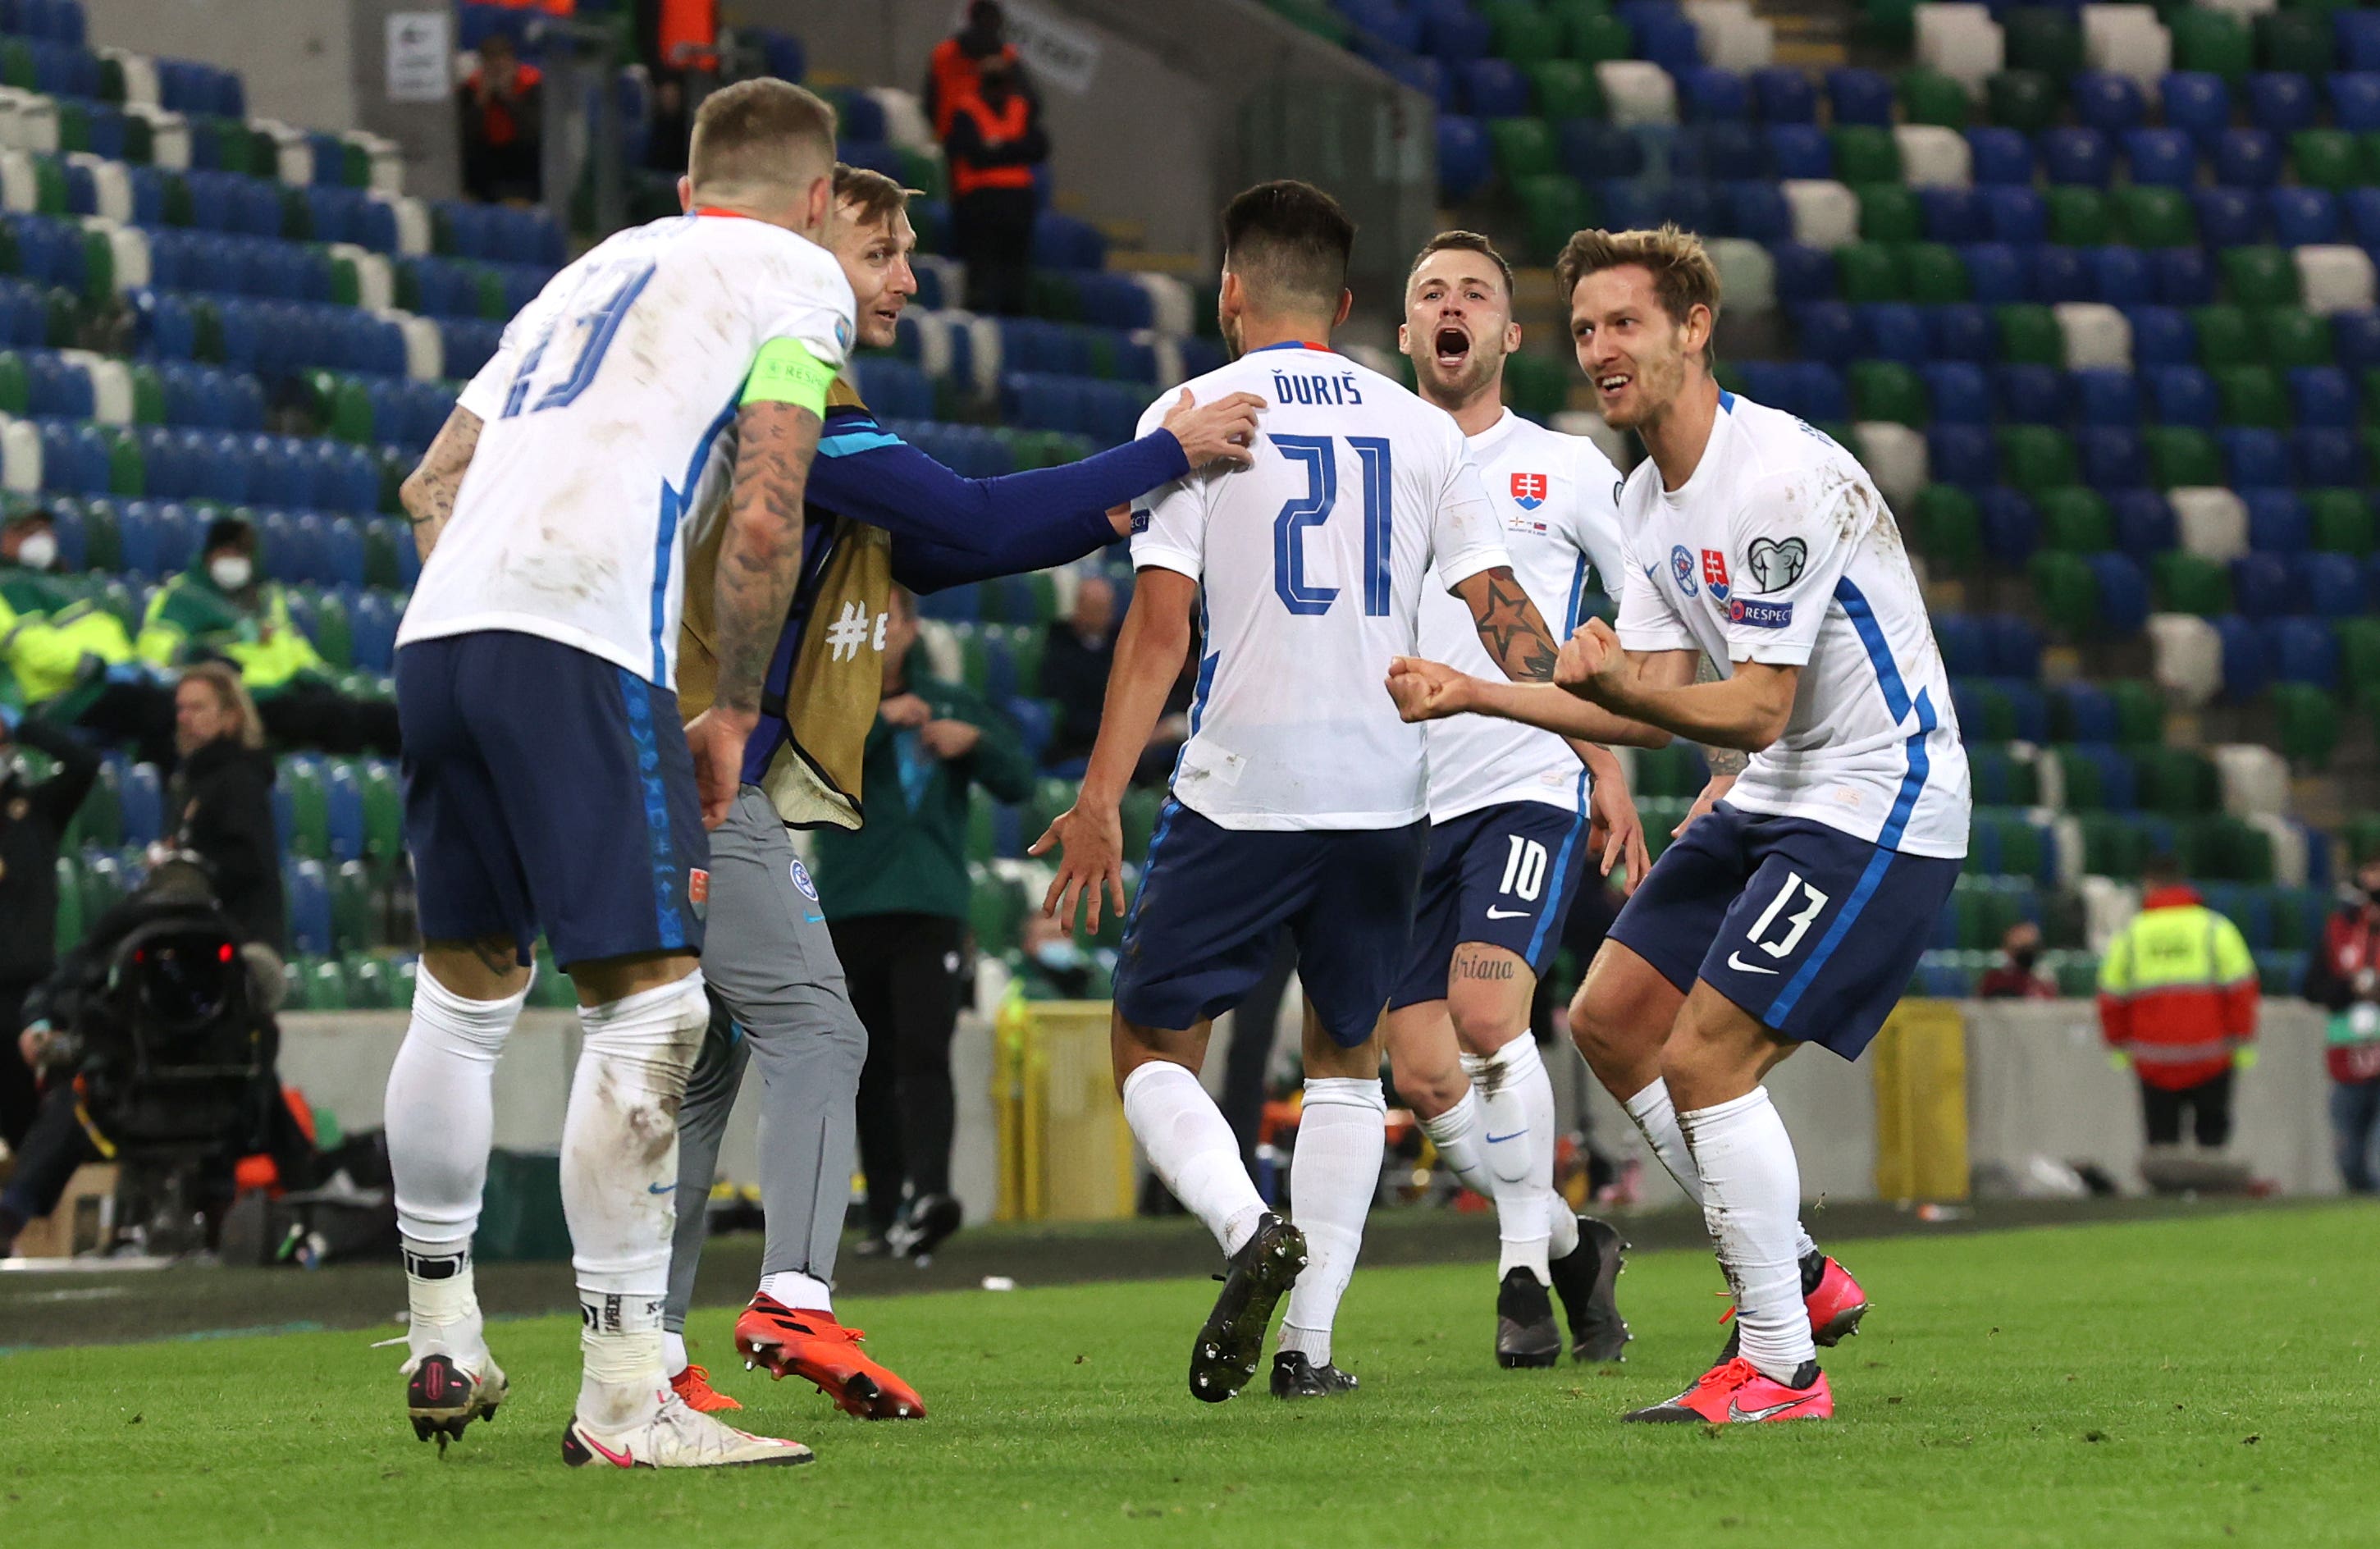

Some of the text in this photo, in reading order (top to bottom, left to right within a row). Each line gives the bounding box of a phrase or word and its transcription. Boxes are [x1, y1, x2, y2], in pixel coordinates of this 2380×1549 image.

[1271, 369, 1362, 405] ĎURIŠ
[1265, 432, 1392, 617] 21
[1745, 606, 1793, 622] RESPECT
[1498, 834, 1548, 902] 10
[1746, 870, 1830, 959] 13
